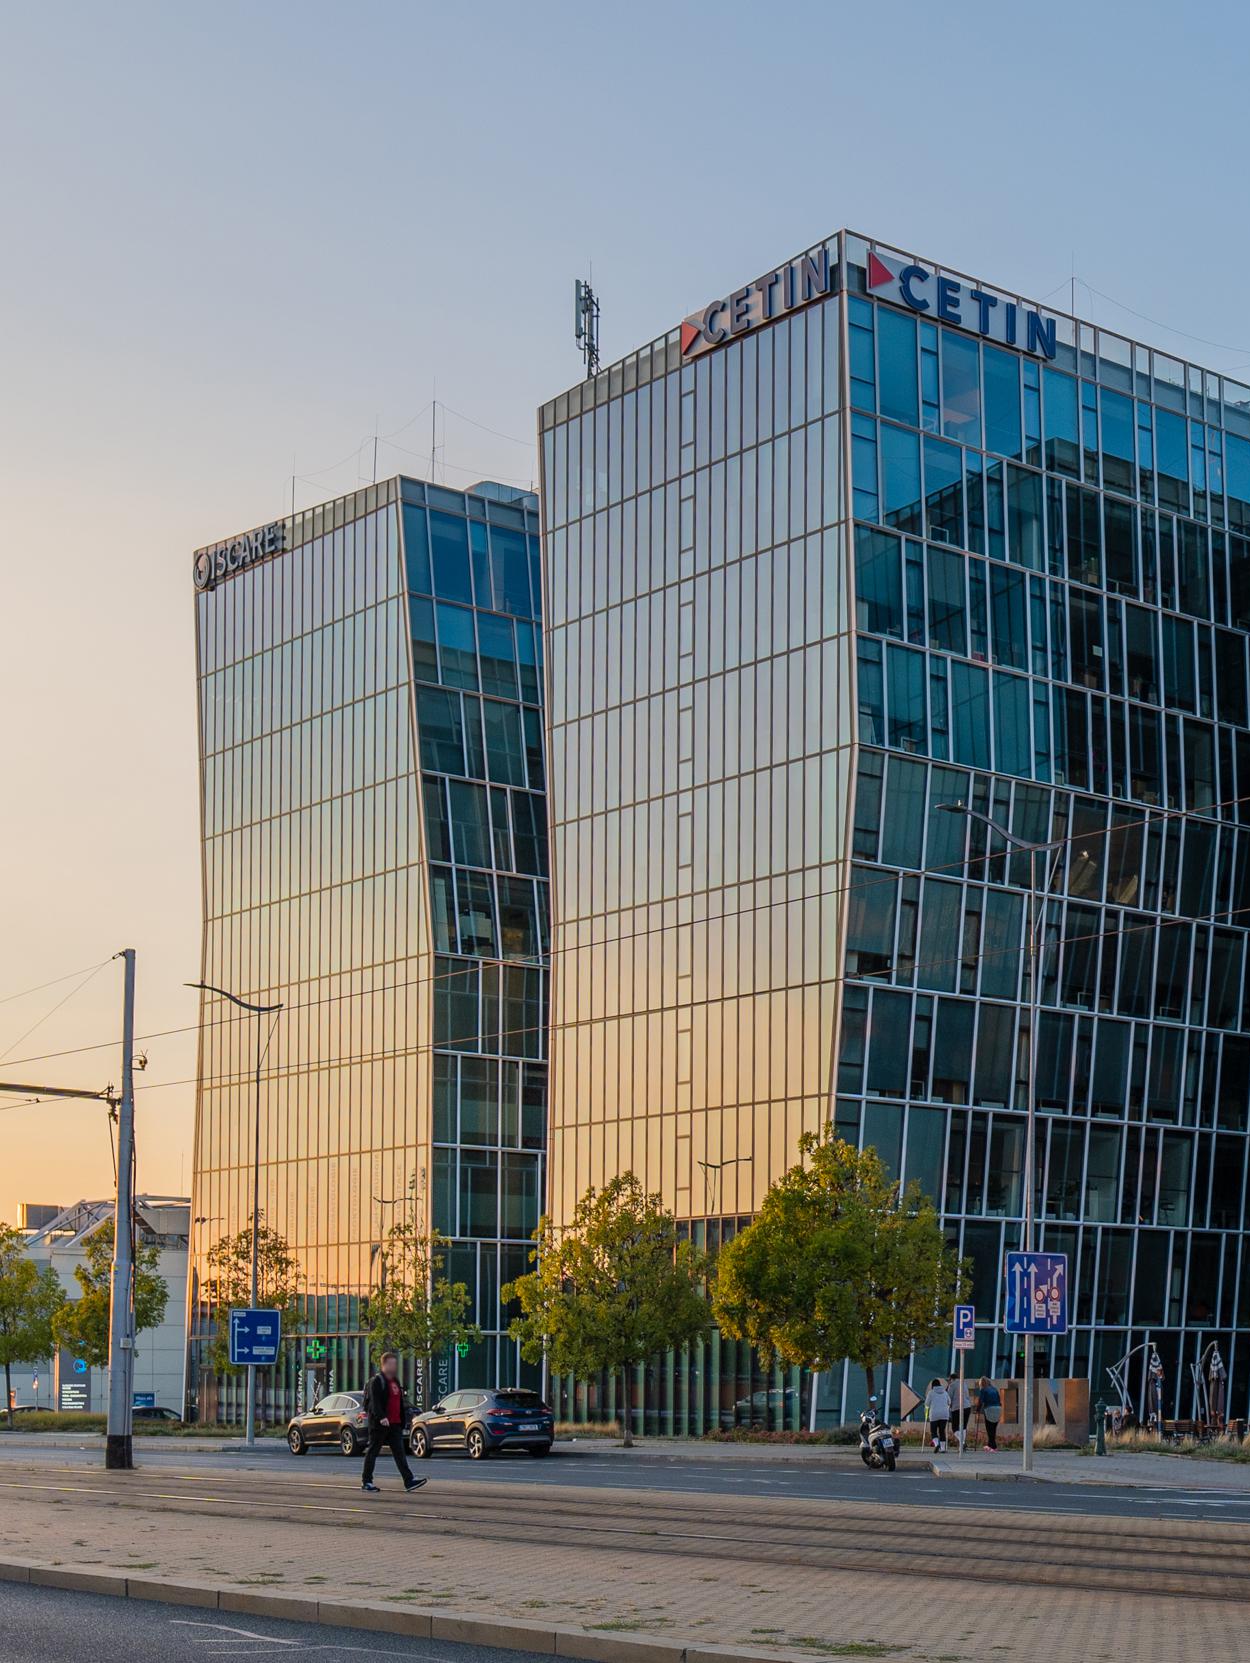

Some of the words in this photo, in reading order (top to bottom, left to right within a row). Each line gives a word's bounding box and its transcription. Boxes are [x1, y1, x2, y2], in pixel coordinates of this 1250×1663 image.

[702, 248, 829, 345] CETIN
[900, 264, 1056, 360] CETIN
[210, 521, 279, 580] ISCARE
[960, 1310, 972, 1330] P
